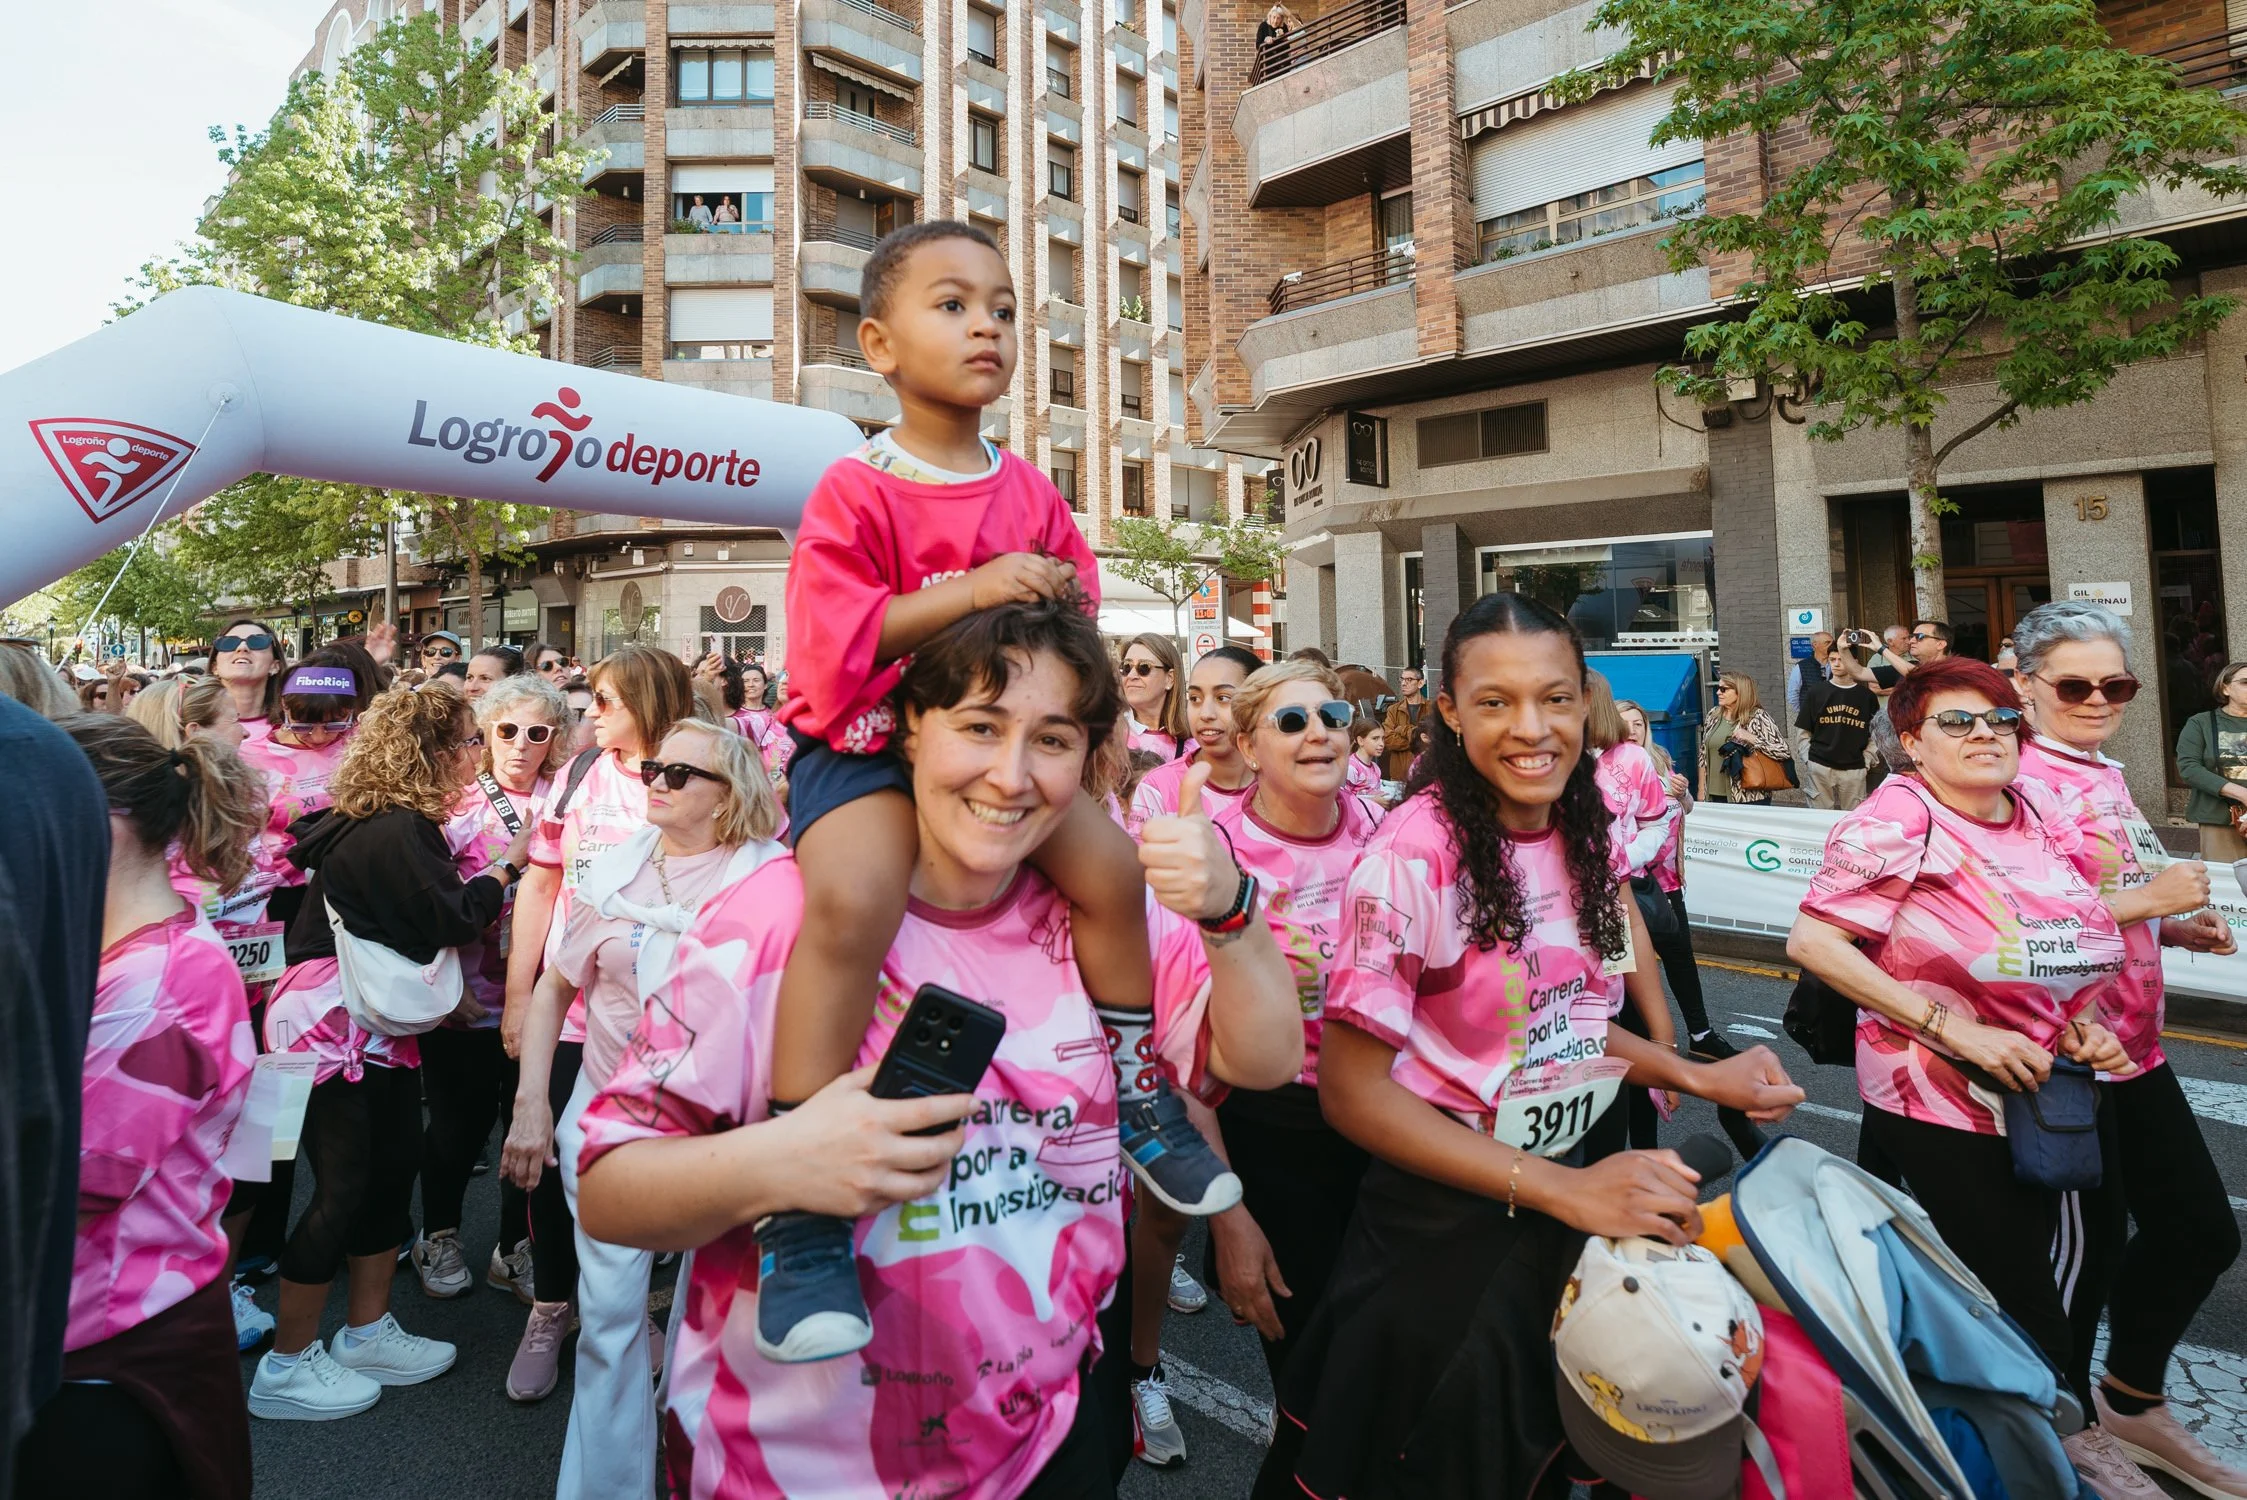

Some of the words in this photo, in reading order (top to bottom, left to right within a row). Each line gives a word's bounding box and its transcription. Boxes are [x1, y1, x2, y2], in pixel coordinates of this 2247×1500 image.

[62, 435, 106, 446] Logroño
[131, 444, 169, 460] deporte
[606, 433, 761, 487] deporte
[2074, 495, 2108, 520] 15
[295, 676, 350, 688] FibroRioja
[1826, 704, 1860, 717] UNIFIED
[1819, 715, 1866, 729] COLLECTIVE
[301, 796, 317, 808] XI
[497, 799, 513, 817] FB
[577, 839, 619, 852] Carr
[1686, 845, 1719, 856] cáncer
[1789, 846, 1824, 857] asocia
[575, 859, 592, 871] po
[1788, 858, 1823, 867] contra
[2015, 911, 2082, 930] Carrera
[2025, 937, 2056, 957] por
[2058, 936, 2077, 954] la
[1523, 951, 1541, 981] XI
[2029, 955, 2126, 978] Investigació
[1528, 976, 1584, 1012] Carrera
[1527, 1021, 1551, 1052] por
[1554, 1011, 1568, 1035] la
[1521, 1090, 1595, 1151] 3911
[949, 1146, 1002, 1190] por
